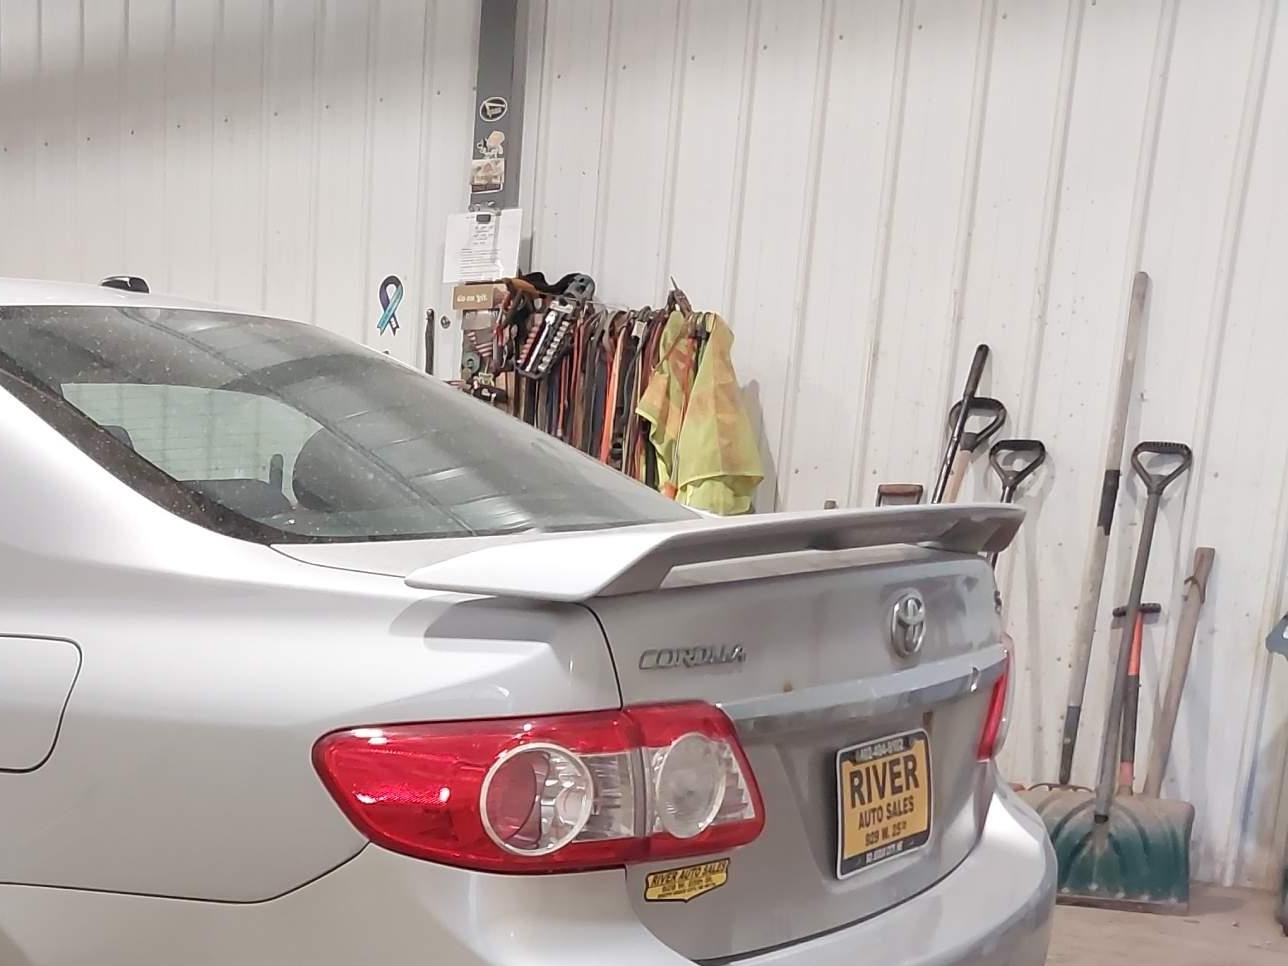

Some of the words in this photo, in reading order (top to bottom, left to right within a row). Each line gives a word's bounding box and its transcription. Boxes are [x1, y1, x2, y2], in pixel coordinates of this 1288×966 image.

[638, 644, 746, 671] COROLLA
[849, 754, 920, 809] RIVER
[858, 804, 884, 831] AUTO
[886, 796, 915, 820] SALES
[651, 871, 679, 888] RIVER
[679, 866, 701, 882] AUTO
[702, 860, 727, 876] SALES
